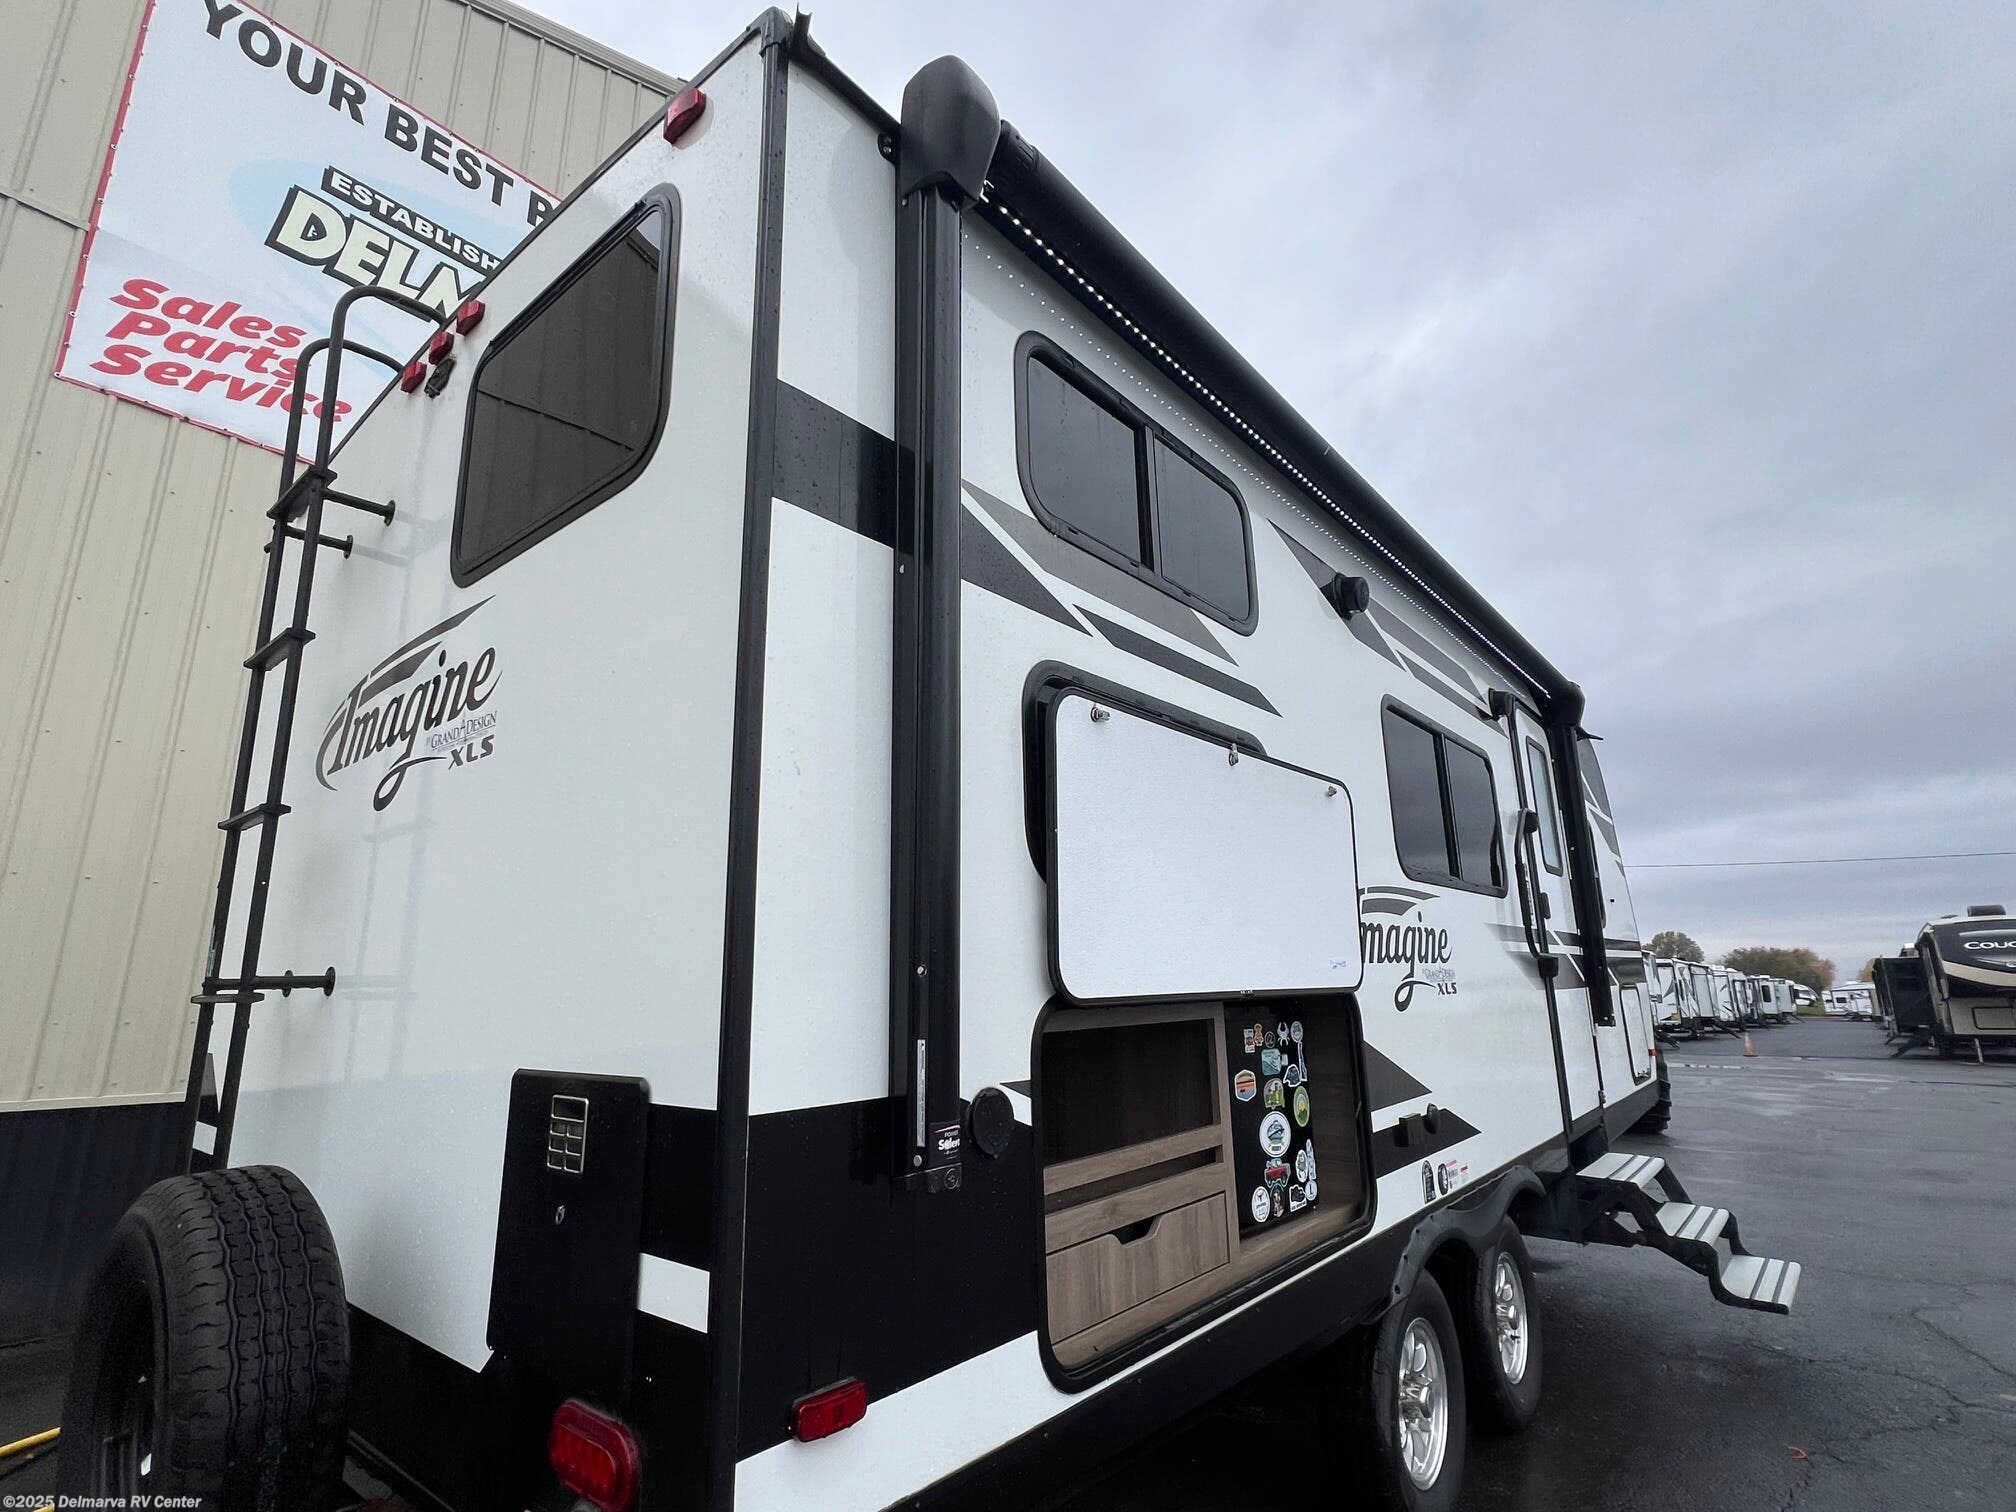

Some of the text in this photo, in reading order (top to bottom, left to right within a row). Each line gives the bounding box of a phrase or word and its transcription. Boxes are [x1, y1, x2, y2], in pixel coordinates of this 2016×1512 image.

[204, 0, 368, 126] YOUR
[385, 103, 514, 207] BEST
[330, 169, 503, 270] ESTABLISH
[105, 311, 312, 381] Parts
[109, 279, 308, 348] Sales
[89, 344, 352, 422] Service
[325, 647, 503, 812] Imagine
[448, 734, 495, 770] XLS
[1360, 910, 1453, 1012] magine
[1437, 982, 1457, 996] XLS
